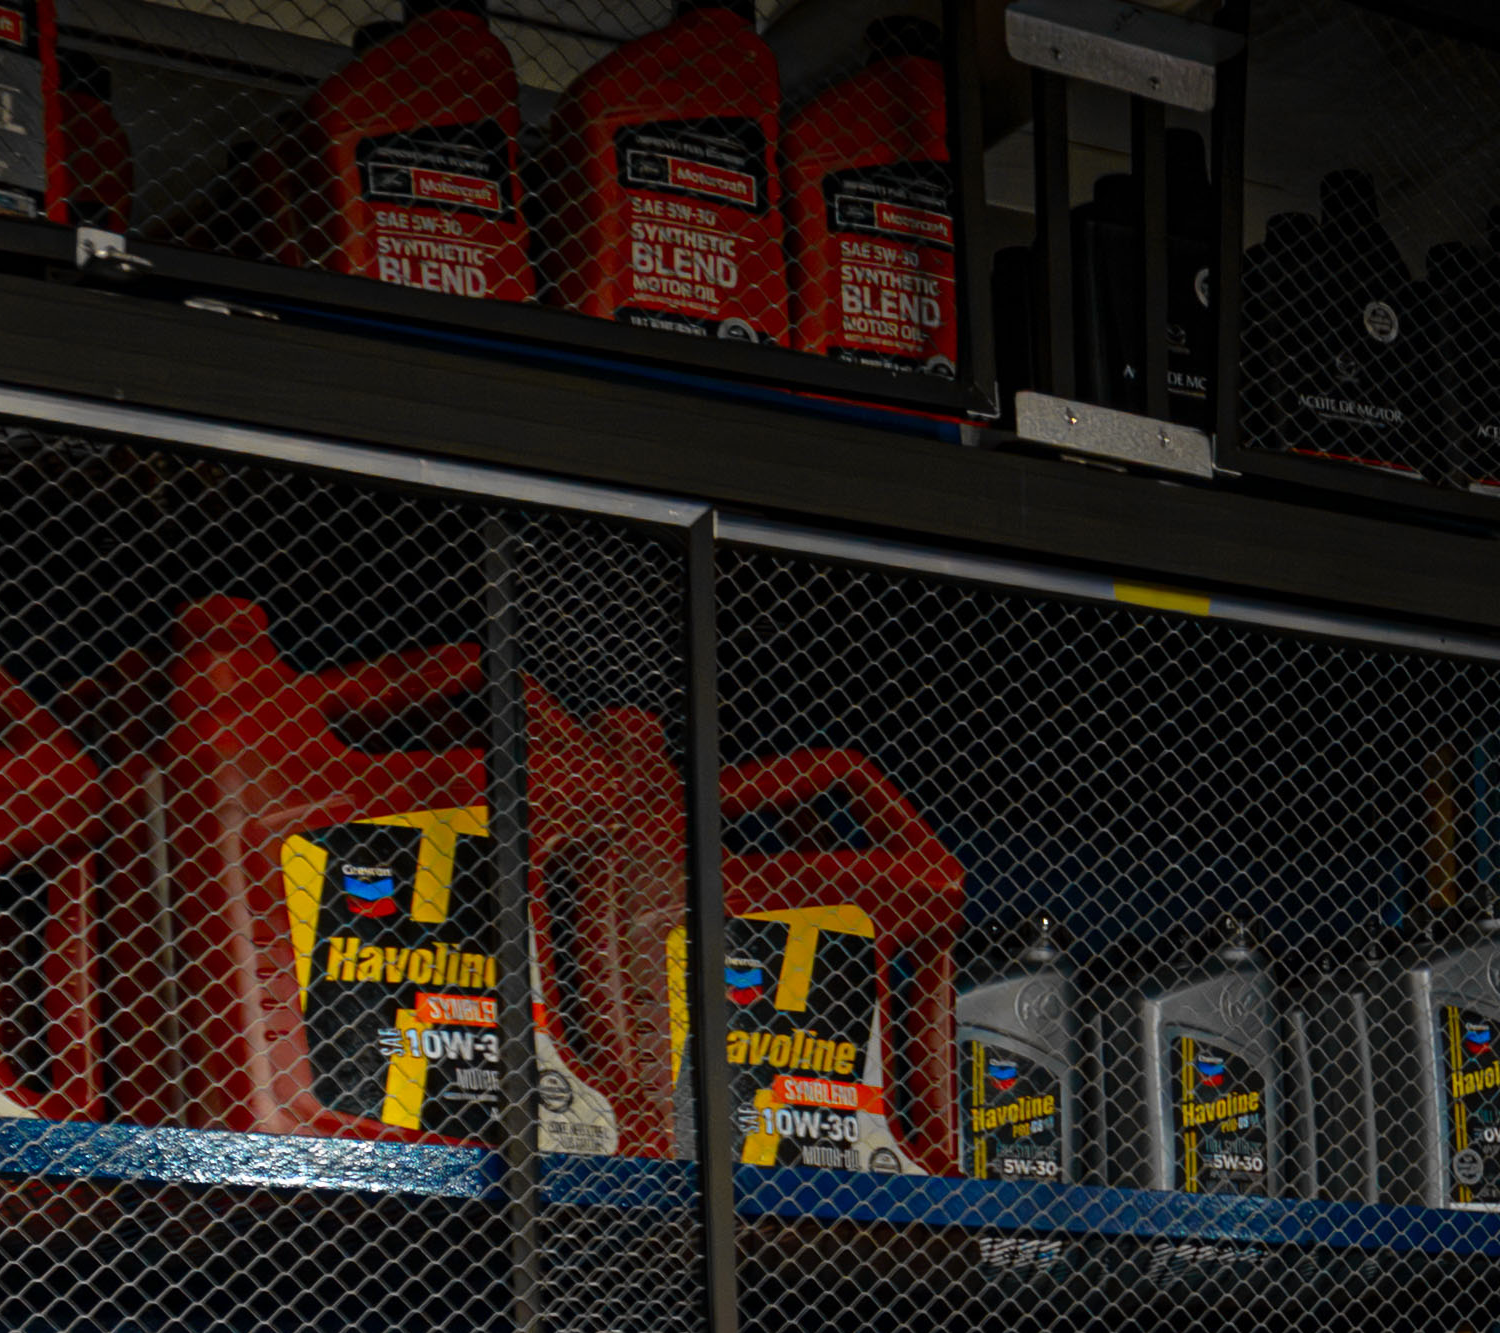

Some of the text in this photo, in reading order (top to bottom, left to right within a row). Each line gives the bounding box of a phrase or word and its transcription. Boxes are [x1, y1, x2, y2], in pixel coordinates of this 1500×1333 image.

[376, 237, 486, 268] SYNTHETIC
[631, 221, 737, 259] SYNTHETIC
[377, 255, 488, 298] BLEND
[631, 242, 739, 288] BLEND
[840, 265, 941, 297] SYNTHETIC
[632, 274, 686, 301] MOTOR
[841, 284, 942, 328] BLEND
[407, 1029, 500, 1062] 10W-3
[725, 1028, 857, 1076] avoline
[760, 1109, 858, 1143] 10W-30
[971, 1094, 1056, 1133] Havoline
[1181, 1090, 1261, 1128] Havoline
[1003, 1158, 1059, 1178] 5W-30
[1212, 1153, 1264, 1172] 5W-30
